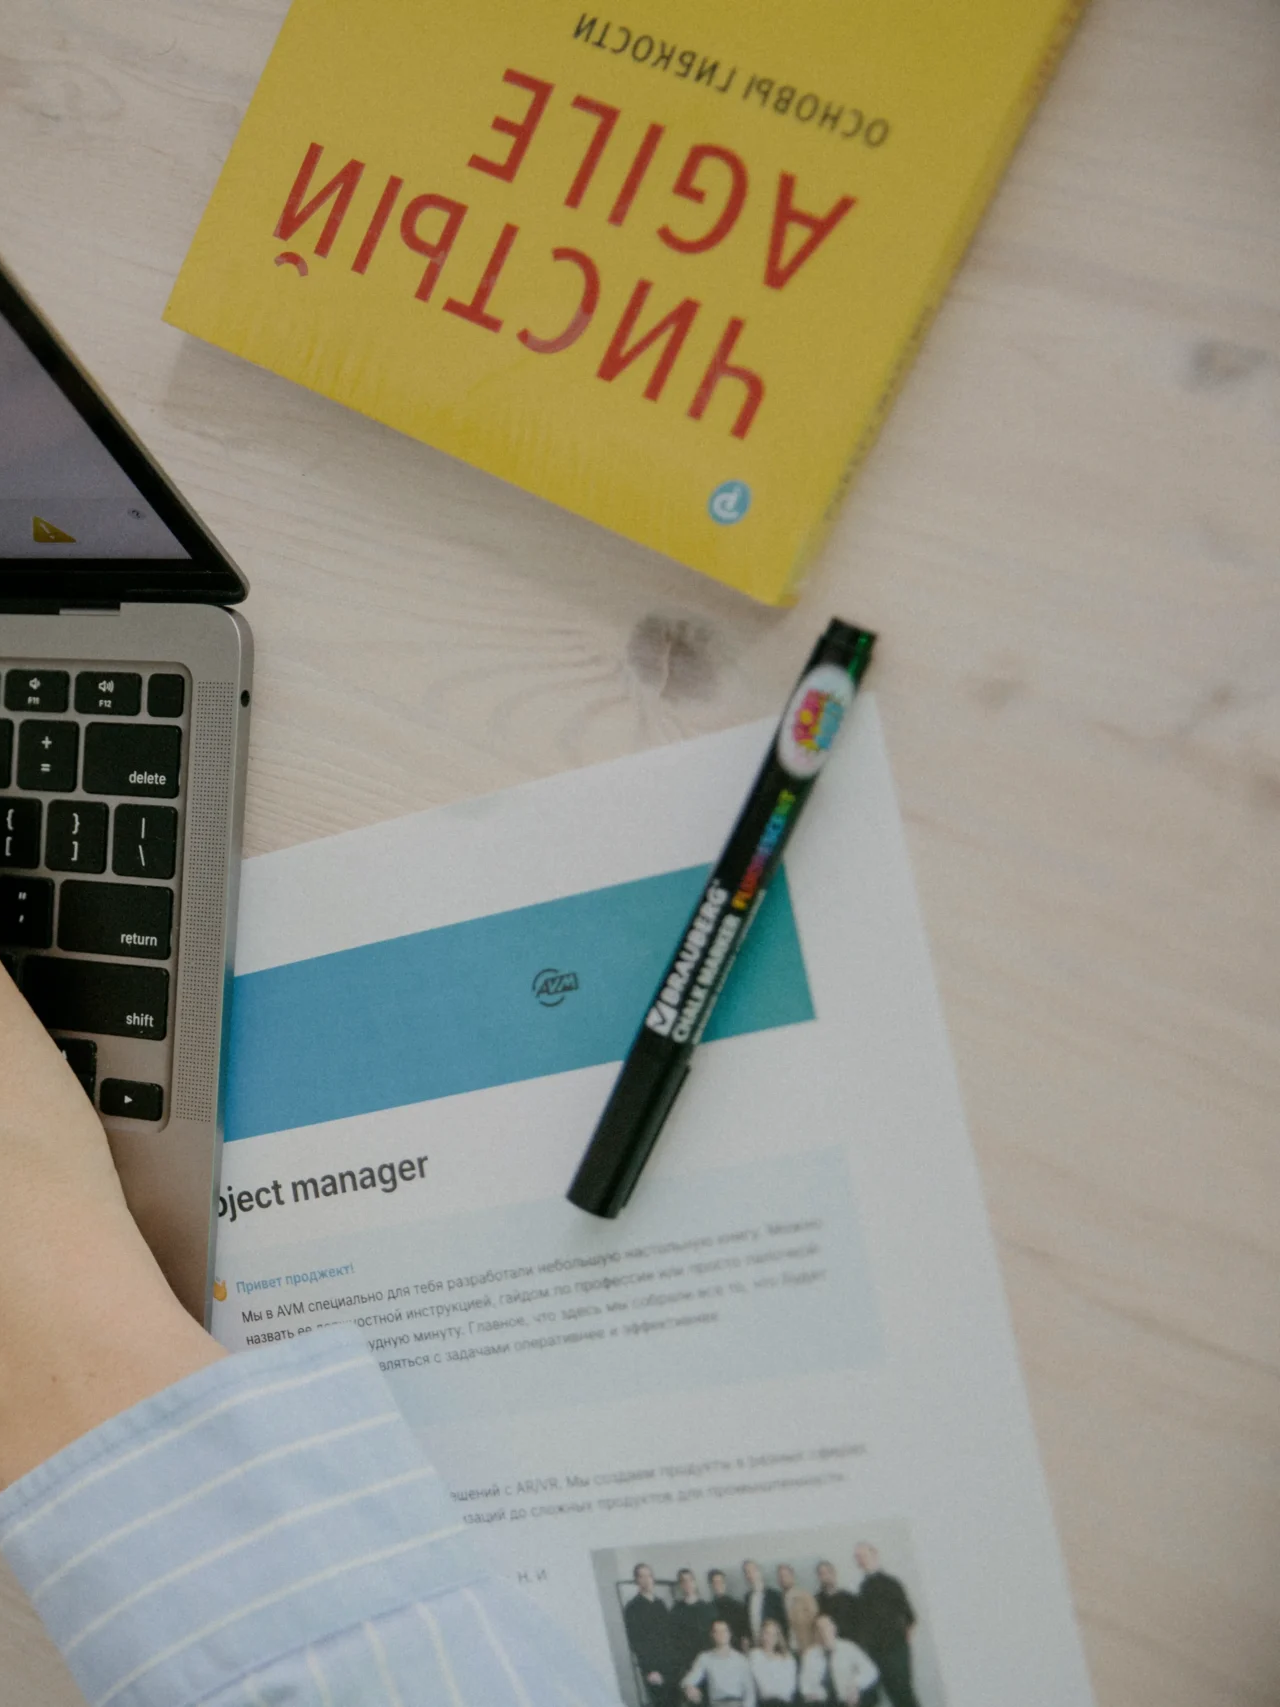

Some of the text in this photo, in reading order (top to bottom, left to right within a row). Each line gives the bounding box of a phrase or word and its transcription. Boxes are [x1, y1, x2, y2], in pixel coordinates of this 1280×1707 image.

[569, 10, 890, 147] ОСНОВЫ ГИБКОСТИ
[467, 67, 858, 291] AGILE
[272, 142, 765, 440] ЧИСТЫЙ
[27, 696, 40, 705] F11
[98, 699, 112, 709] F12
[41, 736, 53, 749] +
[40, 763, 51, 772] =
[128, 771, 167, 786] delete
[6, 808, 14, 831] {
[72, 813, 80, 835] }
[5, 836, 12, 856] [
[71, 841, 78, 861] ]
[138, 845, 146, 867] \
[120, 933, 158, 947] return
[661, 886, 730, 1007] BRAUBERG
[672, 985, 708, 1044] CHALK
[697, 915, 742, 988] MARKER
[126, 1013, 154, 1028] shift
[291, 1155, 429, 1202] manager
[235, 1262, 356, 1296] Привет проджект!
[241, 1307, 264, 1324] Мы
[265, 1308, 274, 1320] в
[274, 1300, 305, 1318] AVM
[306, 1289, 385, 1317] специально
[385, 1286, 411, 1302] для
[411, 1277, 444, 1296] тебя
[445, 1263, 534, 1292] разработали
[536, 1248, 622, 1277] небольшую
[245, 1327, 295, 1346] назвать
[405, 1293, 495, 1324] инструкцией,
[496, 1284, 549, 1306] гайдом
[553, 1283, 572, 1296] по
[412, 1322, 466, 1345] минуту.
[467, 1311, 529, 1336] Главное,
[533, 1311, 556, 1324] что
[560, 1303, 602, 1322] здесь
[605, 1300, 628, 1312] мы
[433, 1351, 442, 1363] с
[444, 1340, 511, 1364] задачами
[515, 1474, 563, 1497] AR/VR.
[564, 1472, 590, 1490] Мы
[508, 1507, 527, 1521] до
